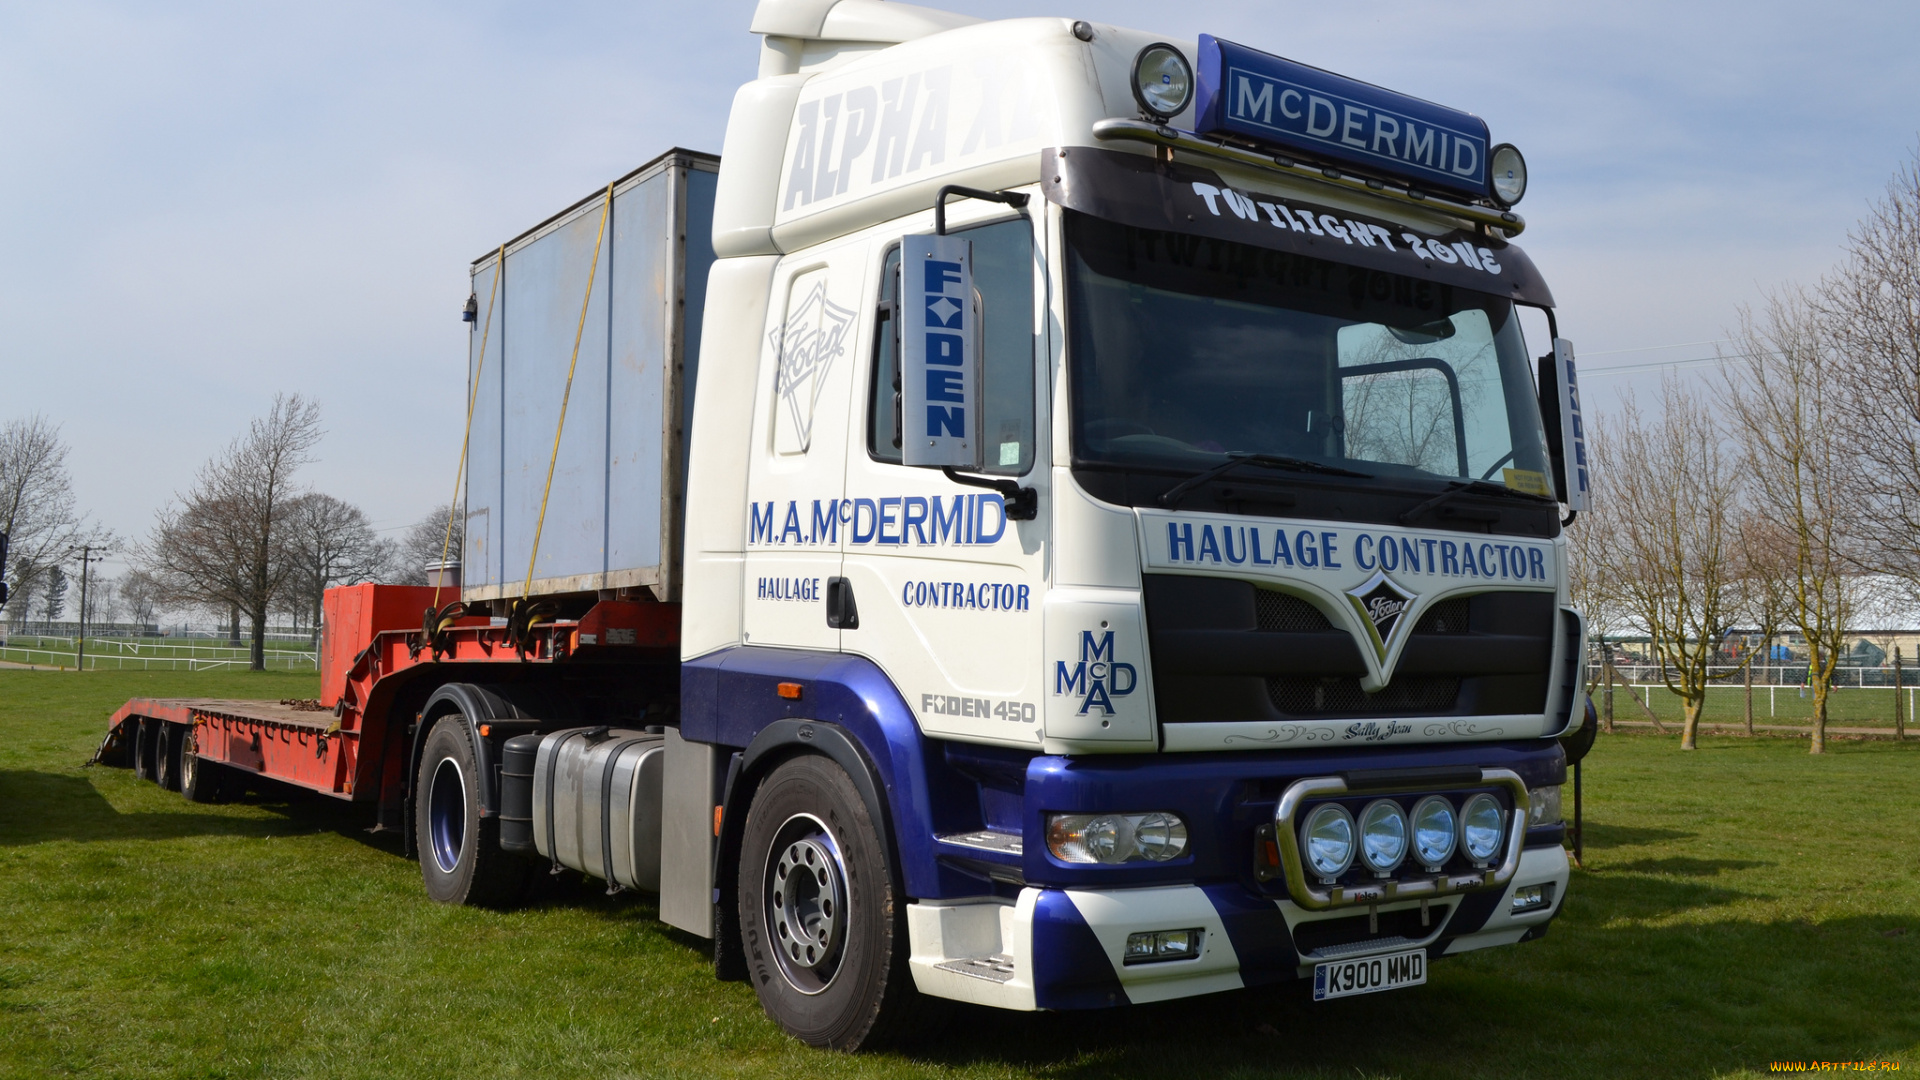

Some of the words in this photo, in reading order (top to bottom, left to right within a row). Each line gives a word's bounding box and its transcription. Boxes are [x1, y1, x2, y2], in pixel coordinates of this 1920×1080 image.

[783, 65, 951, 212] ALPHA
[1236, 75, 1478, 177] McDERMID
[1192, 181, 1398, 253] TWILIGHT
[1407, 233, 1502, 275] ZONE
[924, 260, 965, 439] FODEN
[1167, 522, 1343, 569] HAULAGE
[1354, 533, 1547, 580] CONTRACTOR
[757, 577, 820, 602] HAULAGE
[902, 580, 1031, 612] CONTRACTOR
[1370, 596, 1405, 621] Foden
[921, 694, 991, 719] FODEN
[993, 700, 1036, 724] 450
[1455, 879, 1481, 891] EuroBar
[1329, 960, 1382, 994] K900
[1387, 953, 1422, 985] MMD
